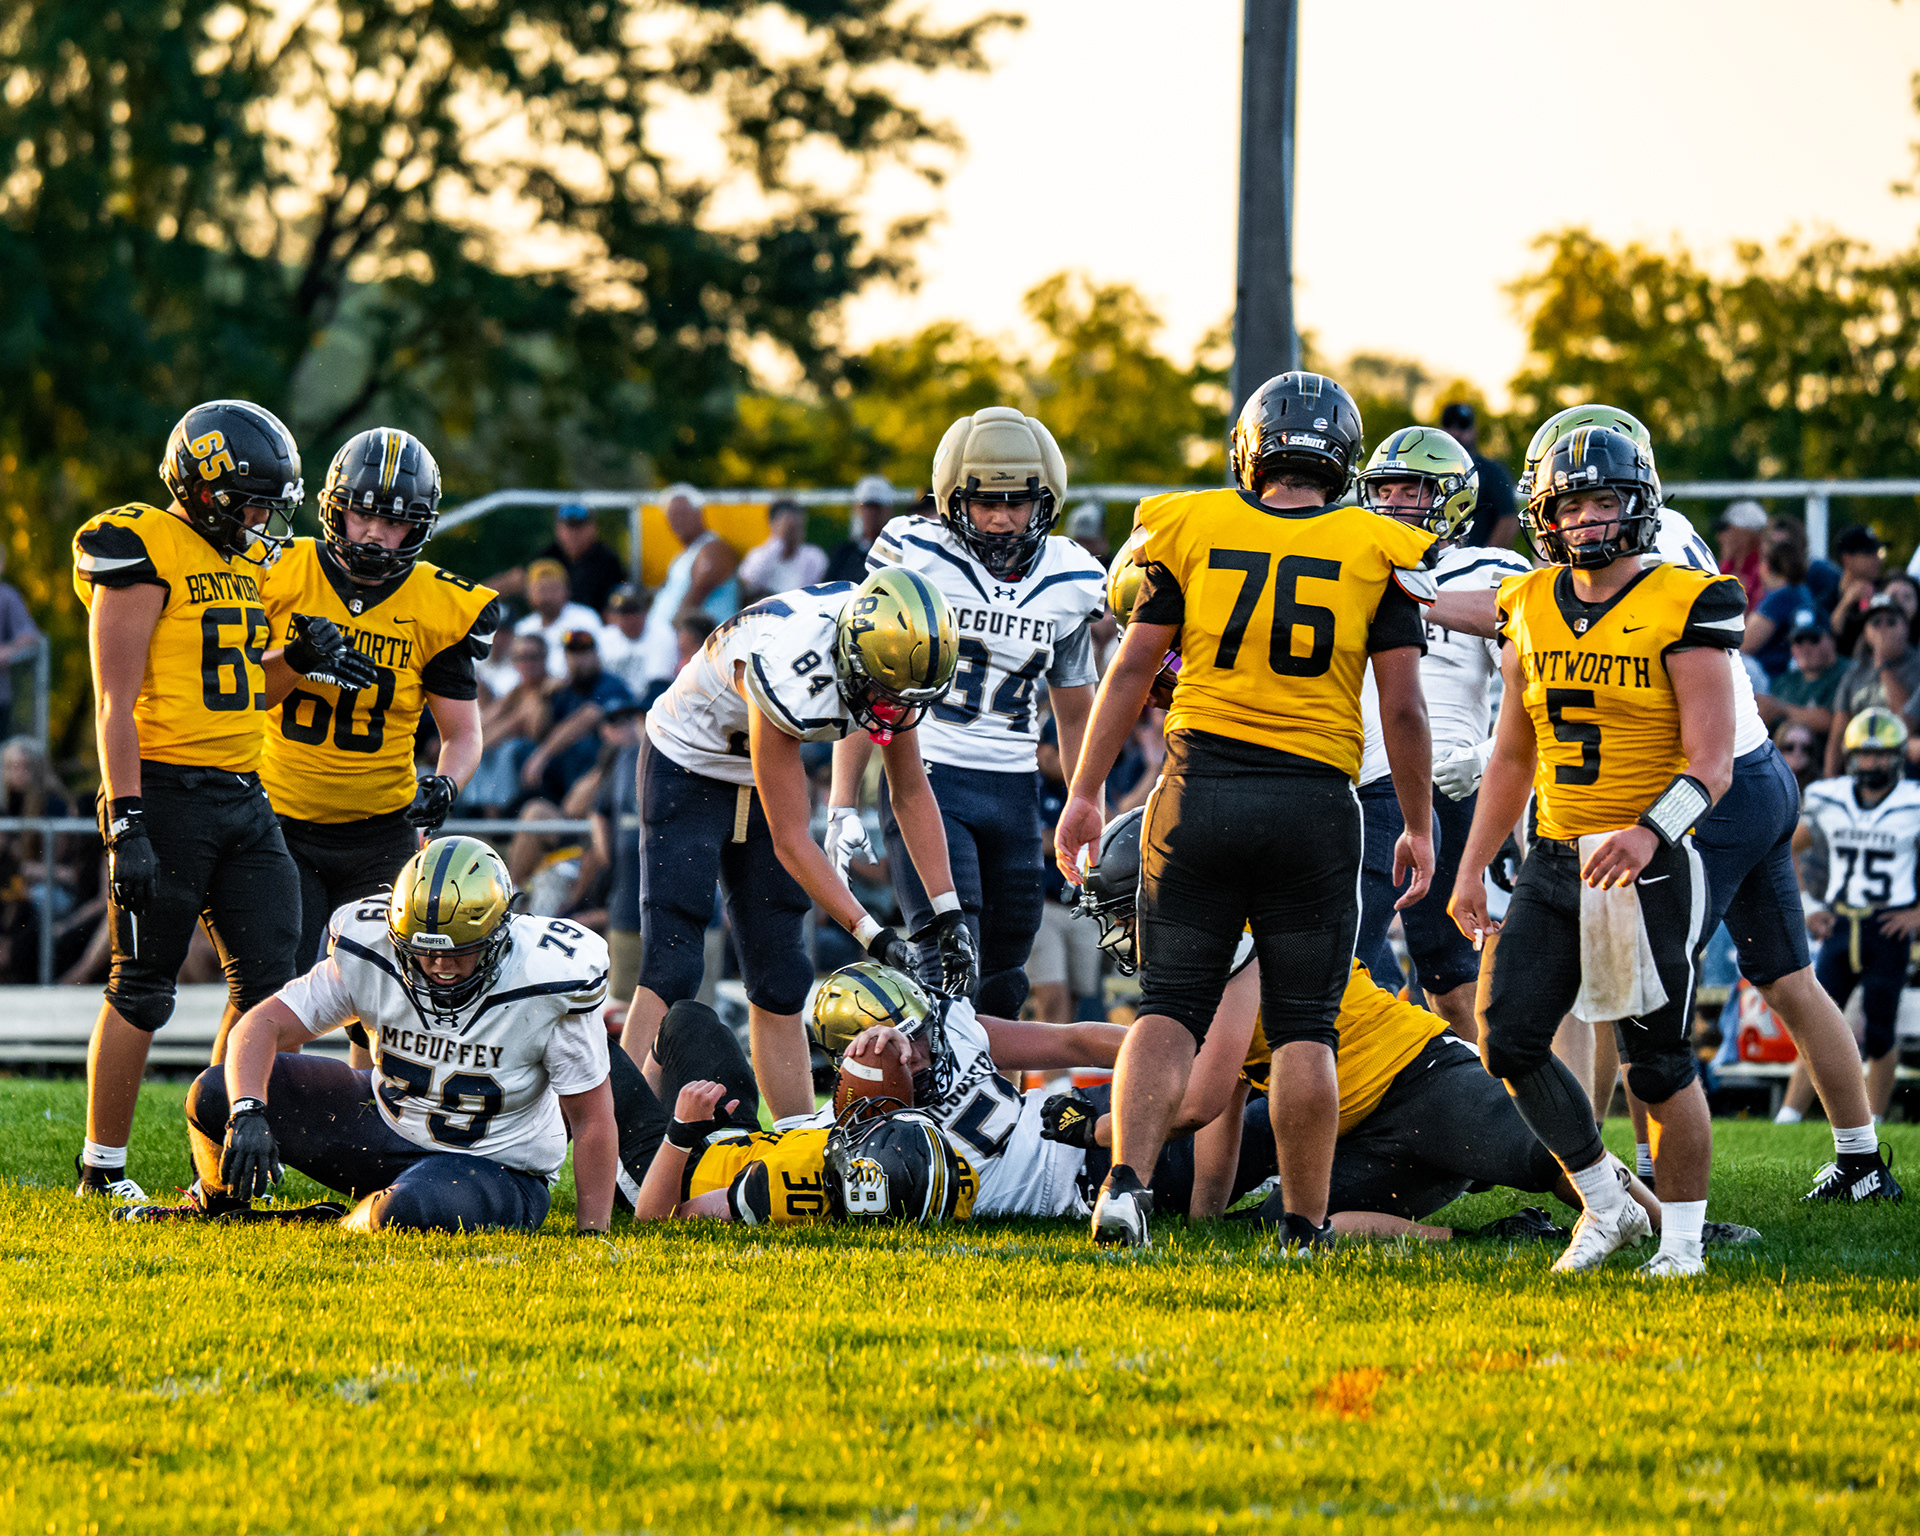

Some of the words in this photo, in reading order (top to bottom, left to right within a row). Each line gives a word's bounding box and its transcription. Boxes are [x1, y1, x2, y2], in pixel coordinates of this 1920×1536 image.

[190, 430, 236, 481] 65
[185, 571, 264, 605] BENTWOR
[1207, 547, 1343, 678] 76
[852, 595, 879, 642] 84
[952, 606, 1054, 645] CGUFFEY
[201, 606, 265, 711] 65
[790, 648, 836, 700] 84
[1522, 649, 1652, 689] NTWORTH
[927, 634, 1051, 734] 34
[281, 664, 397, 754] 60
[1545, 687, 1602, 786] 5
[1832, 845, 1896, 902] 75
[536, 919, 585, 960] 79
[380, 1024, 505, 1069] MCGUFFEY
[376, 1047, 506, 1151] 79
[1058, 1115, 1086, 1131] adidas
[781, 1170, 824, 1216] 30
[1850, 1169, 1882, 1203] NIKE
